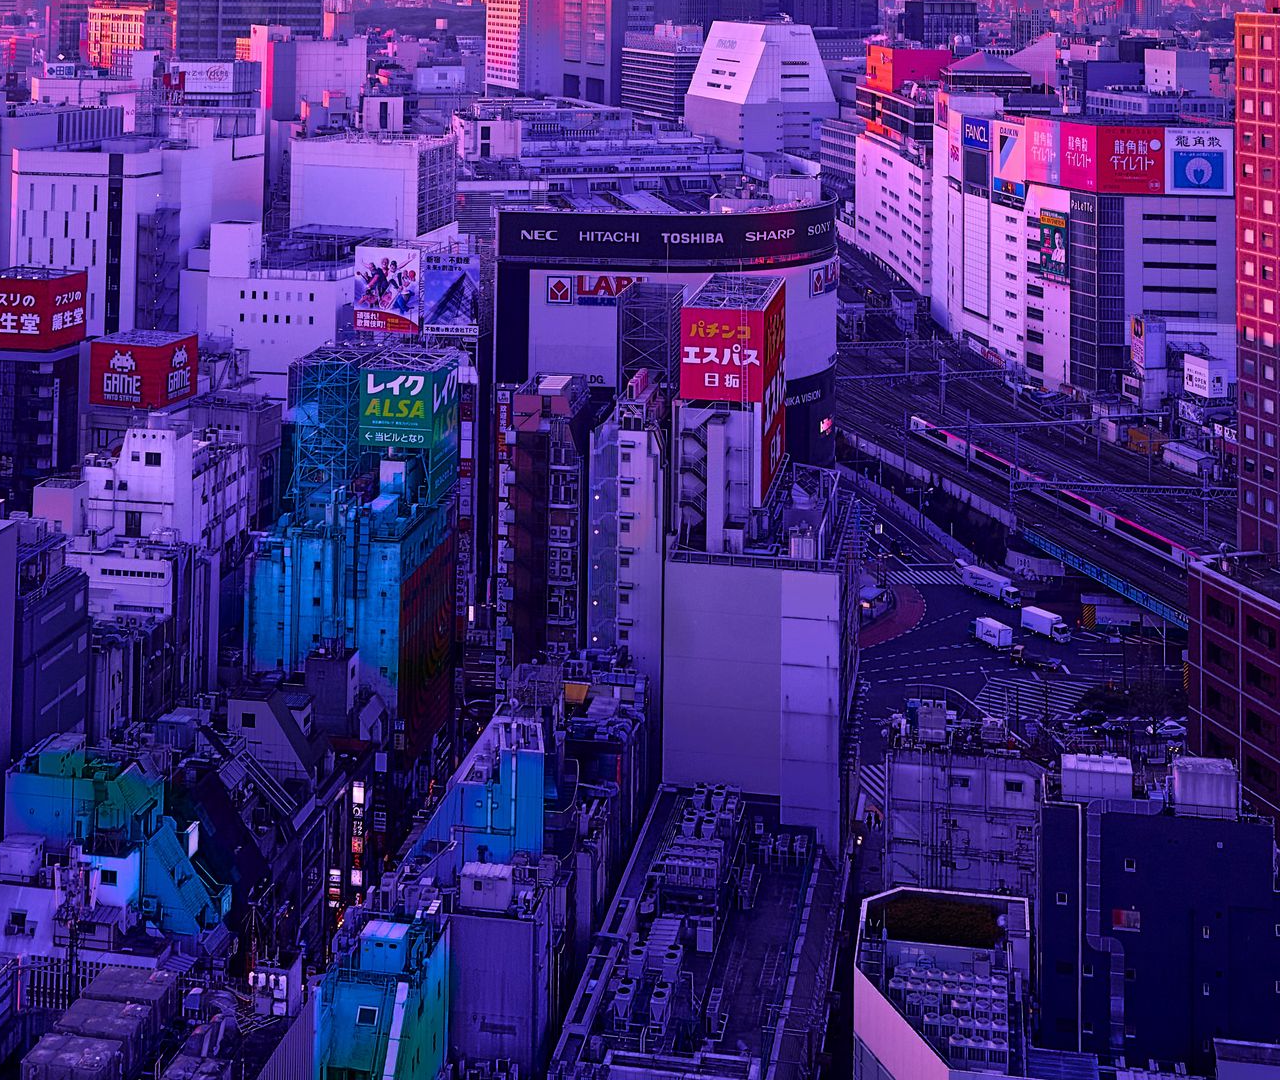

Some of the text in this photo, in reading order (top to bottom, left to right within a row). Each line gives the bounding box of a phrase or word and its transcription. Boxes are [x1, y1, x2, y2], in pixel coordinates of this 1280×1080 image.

[965, 123, 988, 143] FANCL
[1000, 127, 1019, 137] DAIKIN
[1174, 135, 1222, 148] 龍角散
[1114, 139, 1148, 155] 龍角散
[521, 220, 831, 244] NEC HITACHI TOSHIBA SHARP SONY
[55, 291, 82, 306] クスリの
[689, 320, 751, 339] パチンコ
[682, 343, 760, 366] エスパス
[103, 372, 141, 395] GAME
[168, 366, 191, 392] GAME
[367, 373, 425, 396] レイク
[433, 367, 458, 414] レイク
[801, 390, 821, 404] VISION
[364, 398, 424, 418] ALSA
[375, 432, 425, 443] 当ビルとなり
